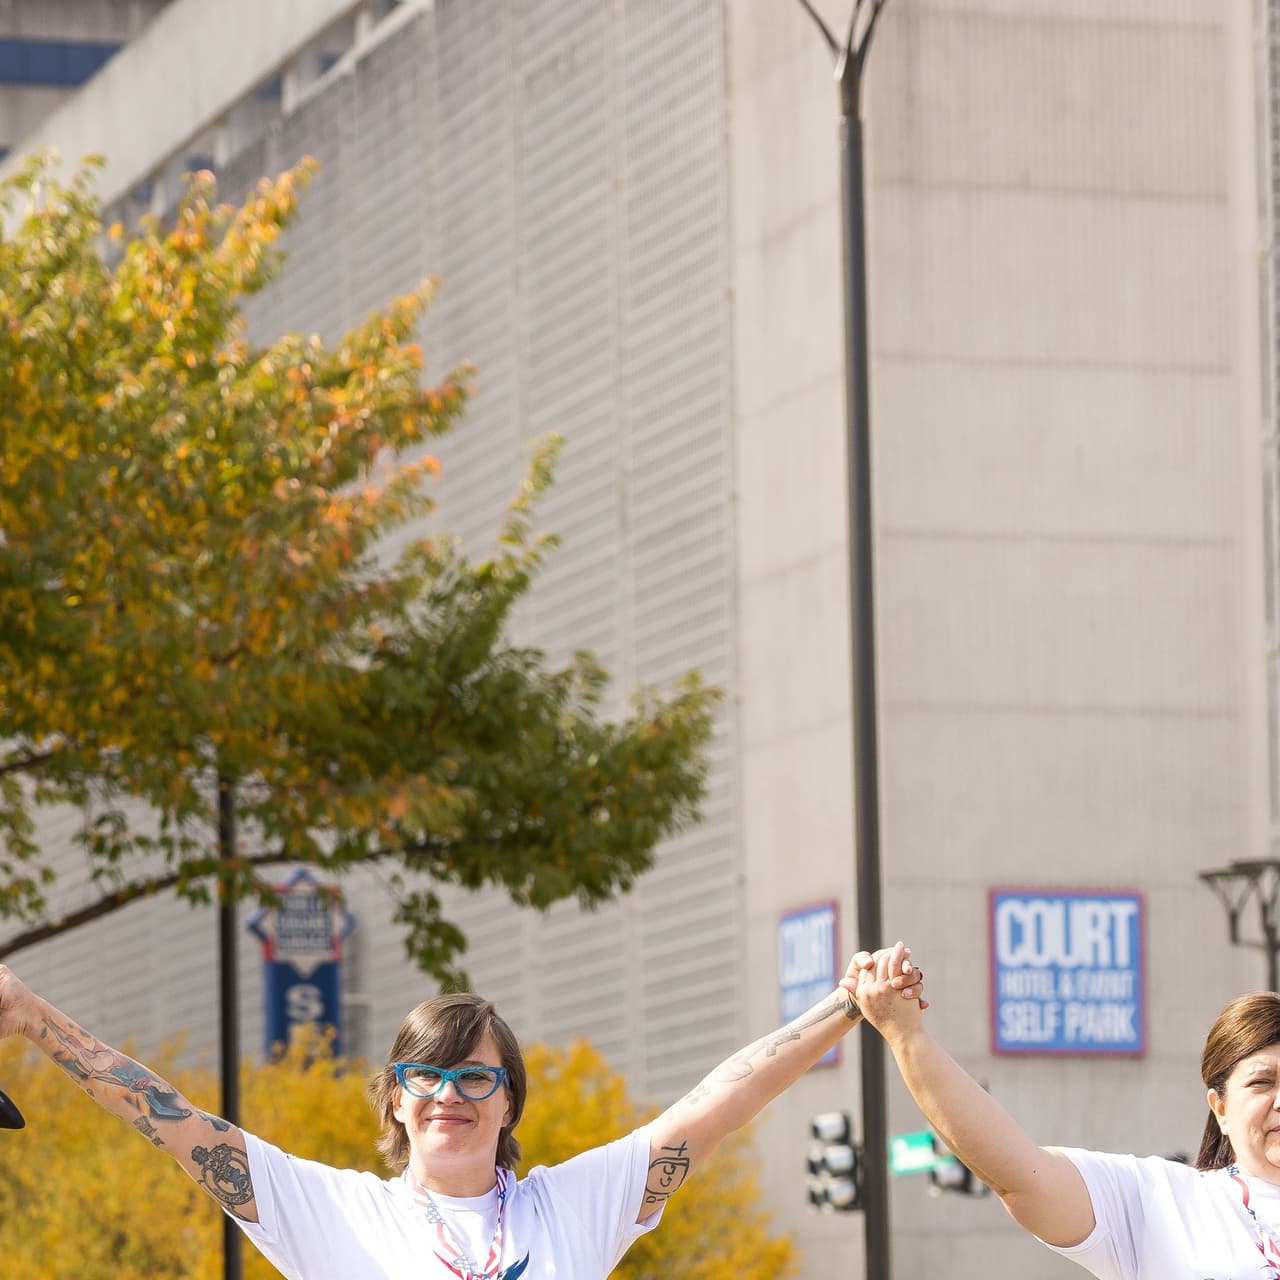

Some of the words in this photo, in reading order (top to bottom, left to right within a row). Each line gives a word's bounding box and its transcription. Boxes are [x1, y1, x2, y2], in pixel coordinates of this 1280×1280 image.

[997, 899, 1139, 967] COURT
[1000, 1000, 1062, 1042] SELF
[1065, 1000, 1137, 1042] PARK
